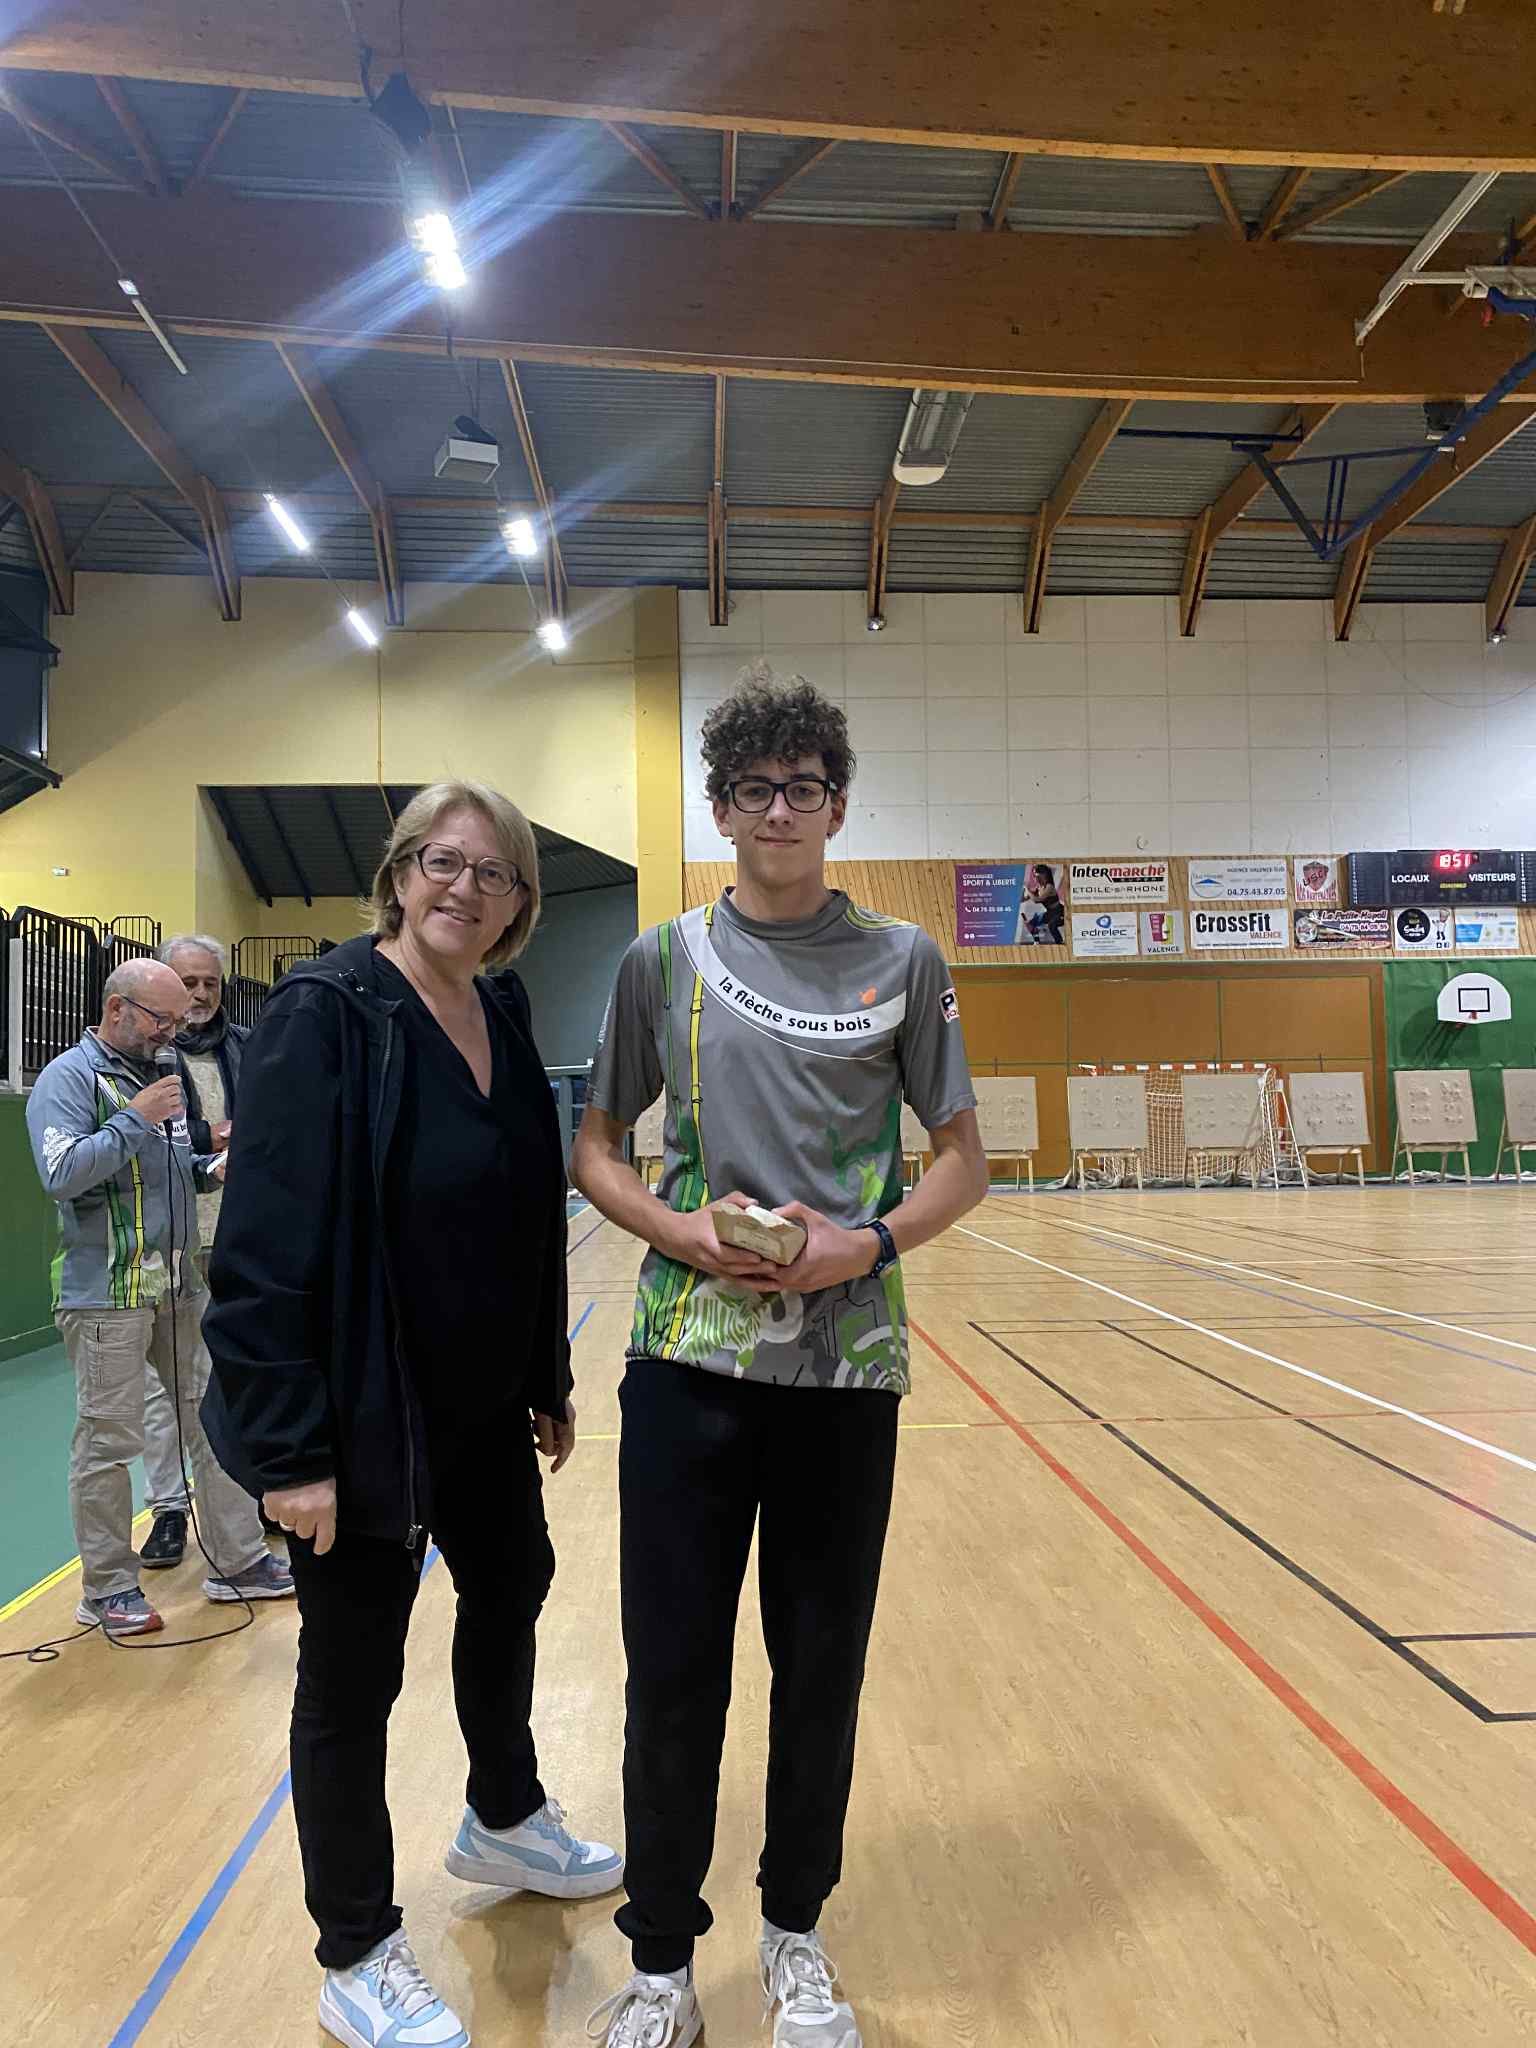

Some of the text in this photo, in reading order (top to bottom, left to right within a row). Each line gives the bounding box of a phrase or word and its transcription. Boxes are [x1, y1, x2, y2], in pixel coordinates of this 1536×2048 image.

[1072, 864, 1166, 883] Intermarché
[1469, 873, 1516, 882] VISITEURS
[992, 877, 1016, 886] LIBERTÉ
[1391, 874, 1430, 883] LOCAUX
[1195, 912, 1272, 933] CrossFit
[1249, 931, 1282, 939] VALENCE
[1147, 945, 1181, 953] VALENCE
[718, 976, 872, 1033] la flèche sous bois
